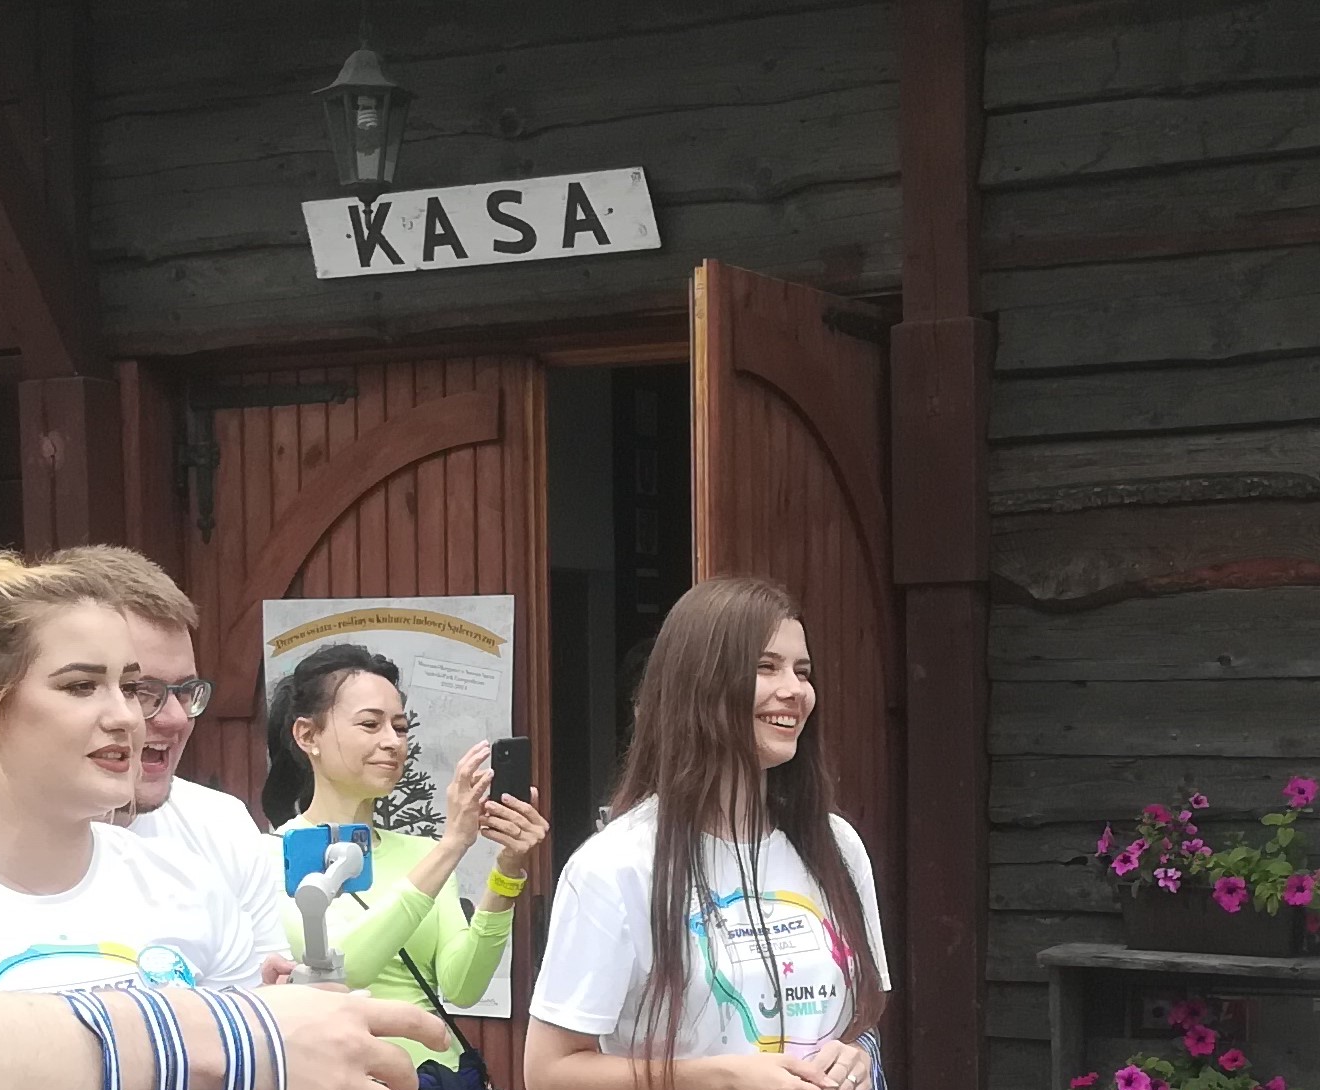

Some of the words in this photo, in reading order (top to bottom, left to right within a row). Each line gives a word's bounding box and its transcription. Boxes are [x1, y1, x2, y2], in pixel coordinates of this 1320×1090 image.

[347, 182, 611, 268] KASA
[785, 985, 814, 1001] RUN
[818, 984, 827, 998] 4
